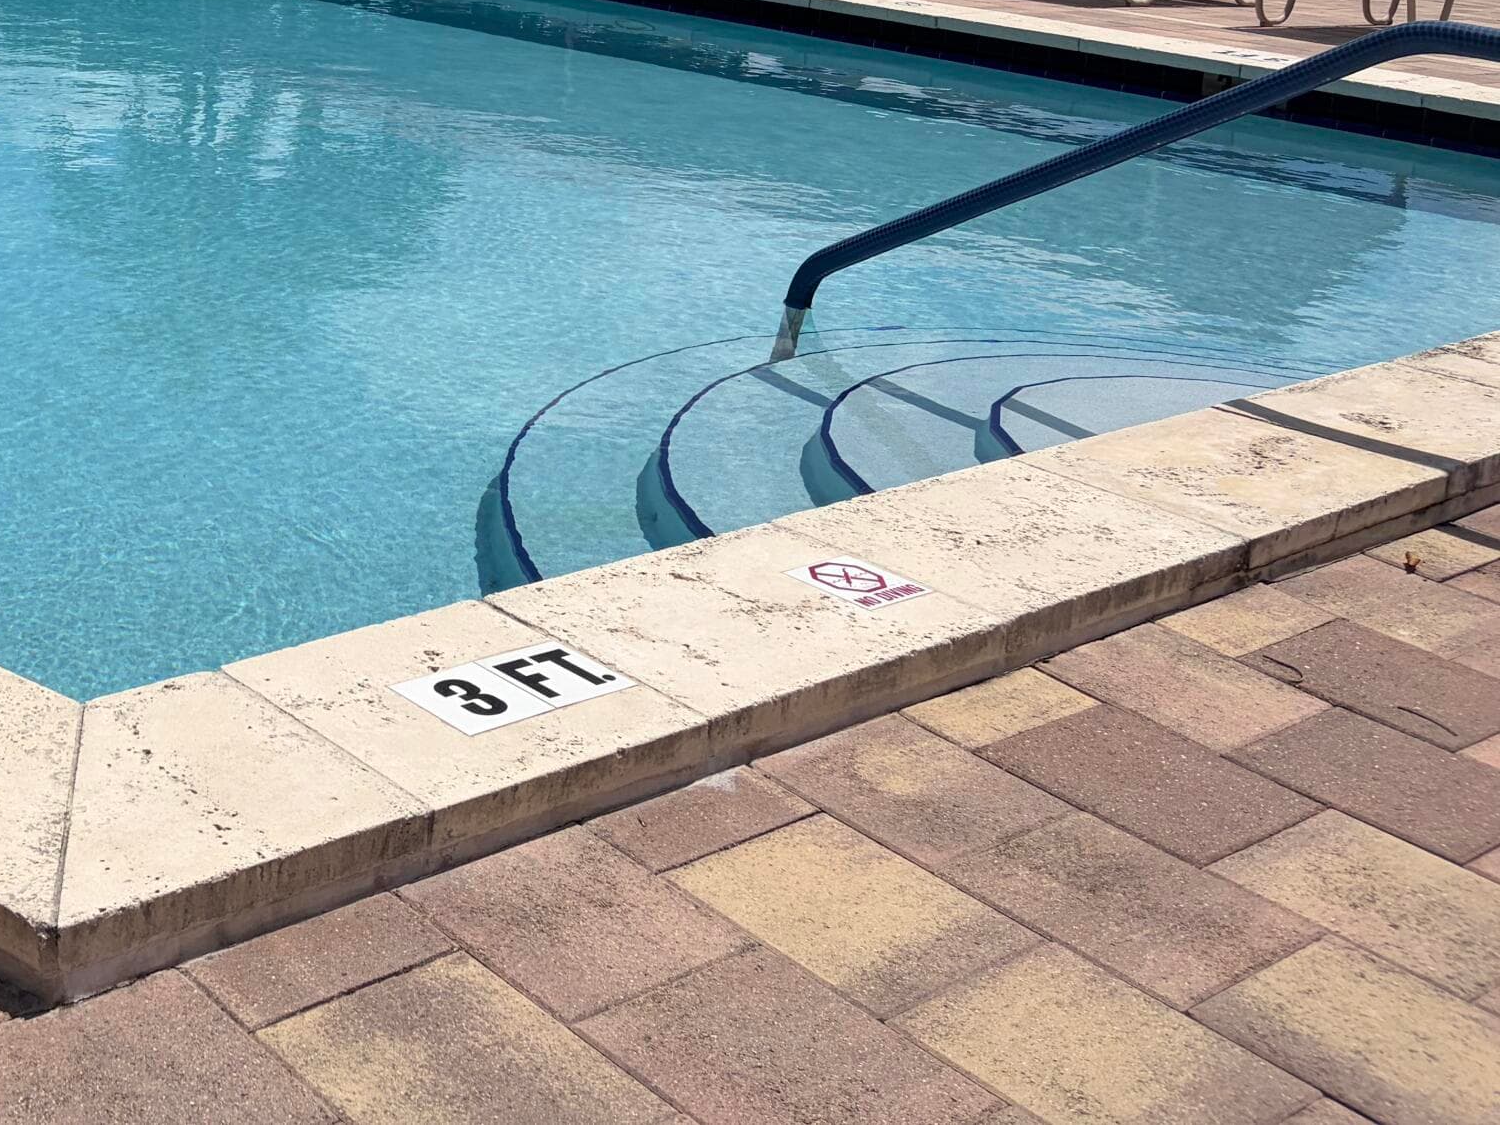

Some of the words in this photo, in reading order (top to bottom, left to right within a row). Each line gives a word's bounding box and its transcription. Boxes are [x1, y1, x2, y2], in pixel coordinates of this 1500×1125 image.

[854, 596, 881, 607] NO
[874, 584, 925, 602] DIVING
[433, 678, 508, 716] 3
[493, 648, 617, 698] FT.
